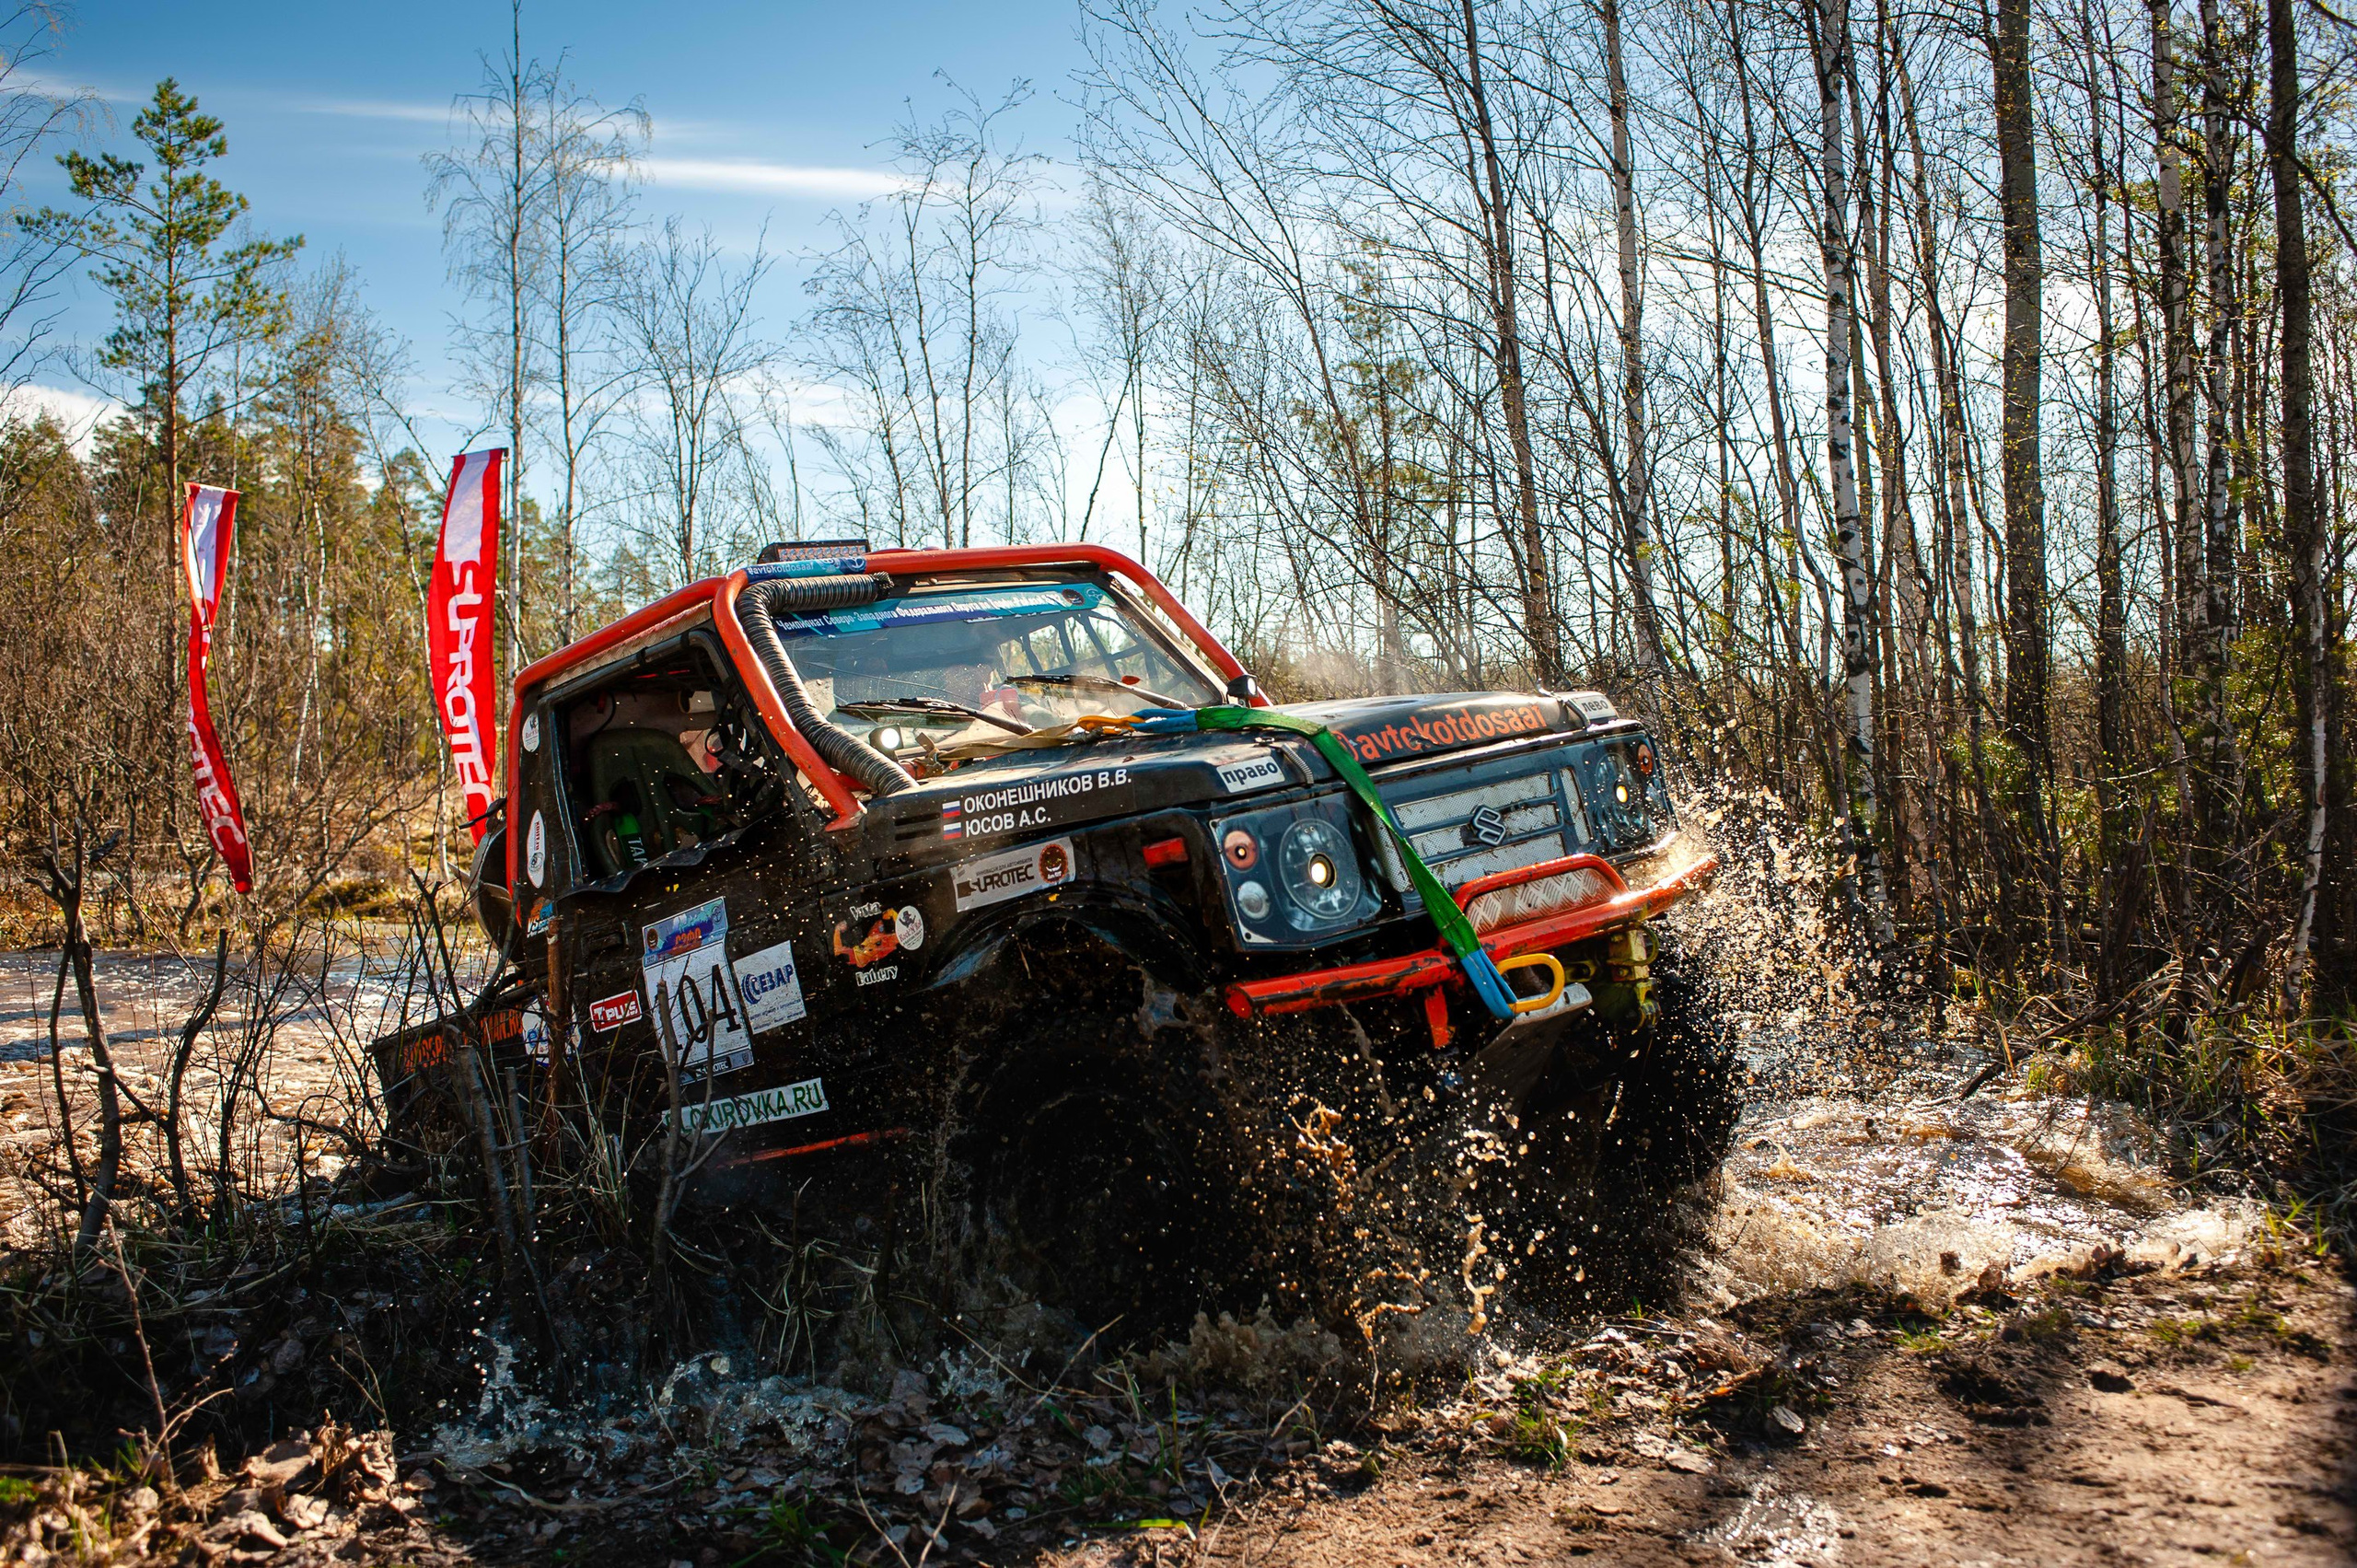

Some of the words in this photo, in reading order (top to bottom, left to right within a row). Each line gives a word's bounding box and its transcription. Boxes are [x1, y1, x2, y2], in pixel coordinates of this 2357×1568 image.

[776, 617, 824, 631] Чемпионат
[823, 610, 896, 625] Северо-Западного
[896, 605, 953, 618] Федерального
[1581, 700, 1608, 713] лево
[1222, 761, 1278, 784] право
[964, 774, 1093, 814] ОКОНЕШНИКОВ
[1098, 769, 1132, 789] В.В.
[966, 812, 1015, 838] ЮСОВ
[1019, 807, 1051, 827] А.С.
